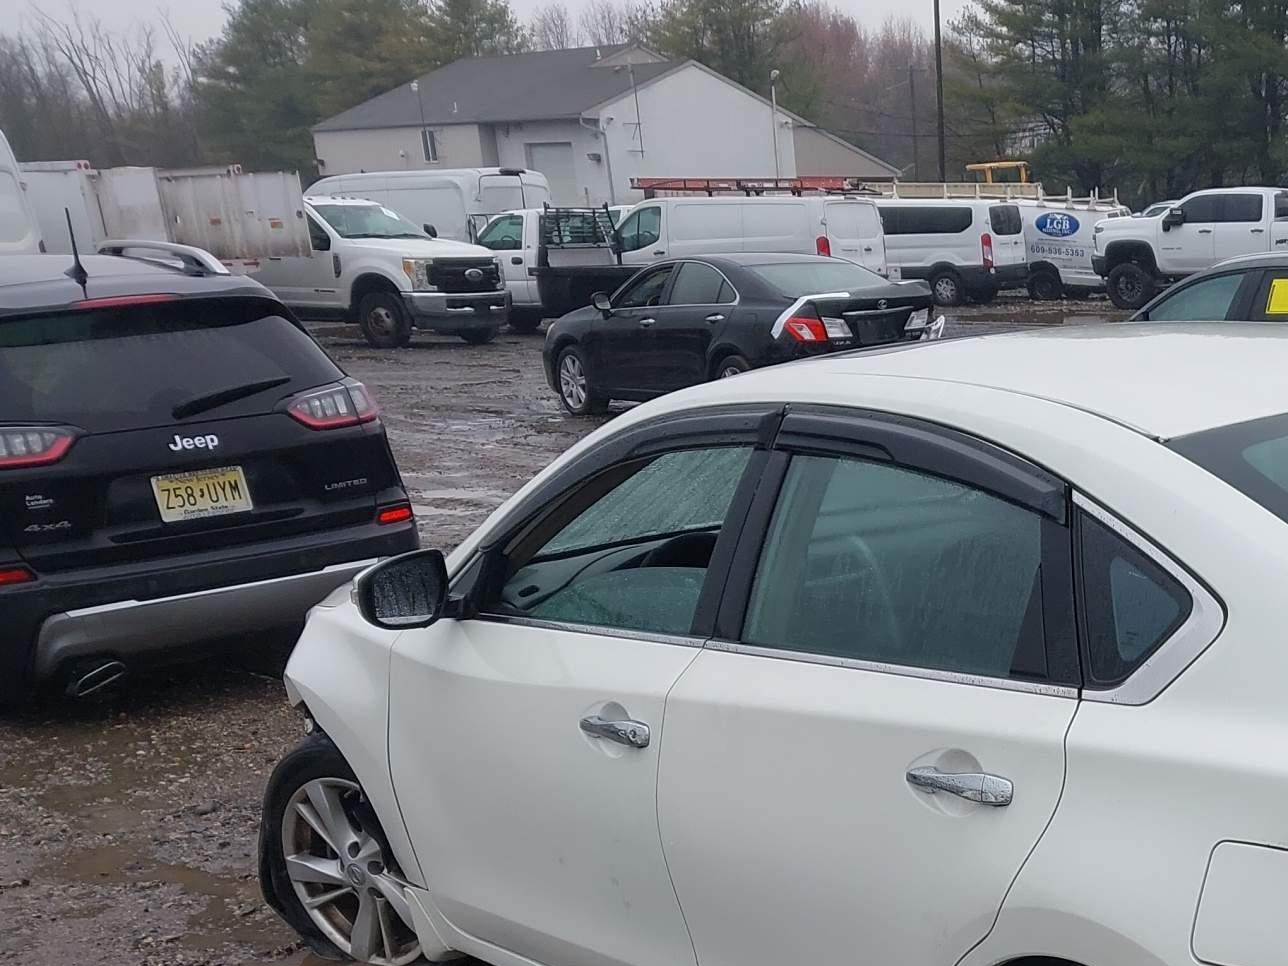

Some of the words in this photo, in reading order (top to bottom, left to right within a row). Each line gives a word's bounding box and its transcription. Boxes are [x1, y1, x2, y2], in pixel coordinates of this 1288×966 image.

[1046, 219, 1070, 229] LGB
[169, 434, 218, 451] Jeep
[324, 477, 368, 491] LIMITED
